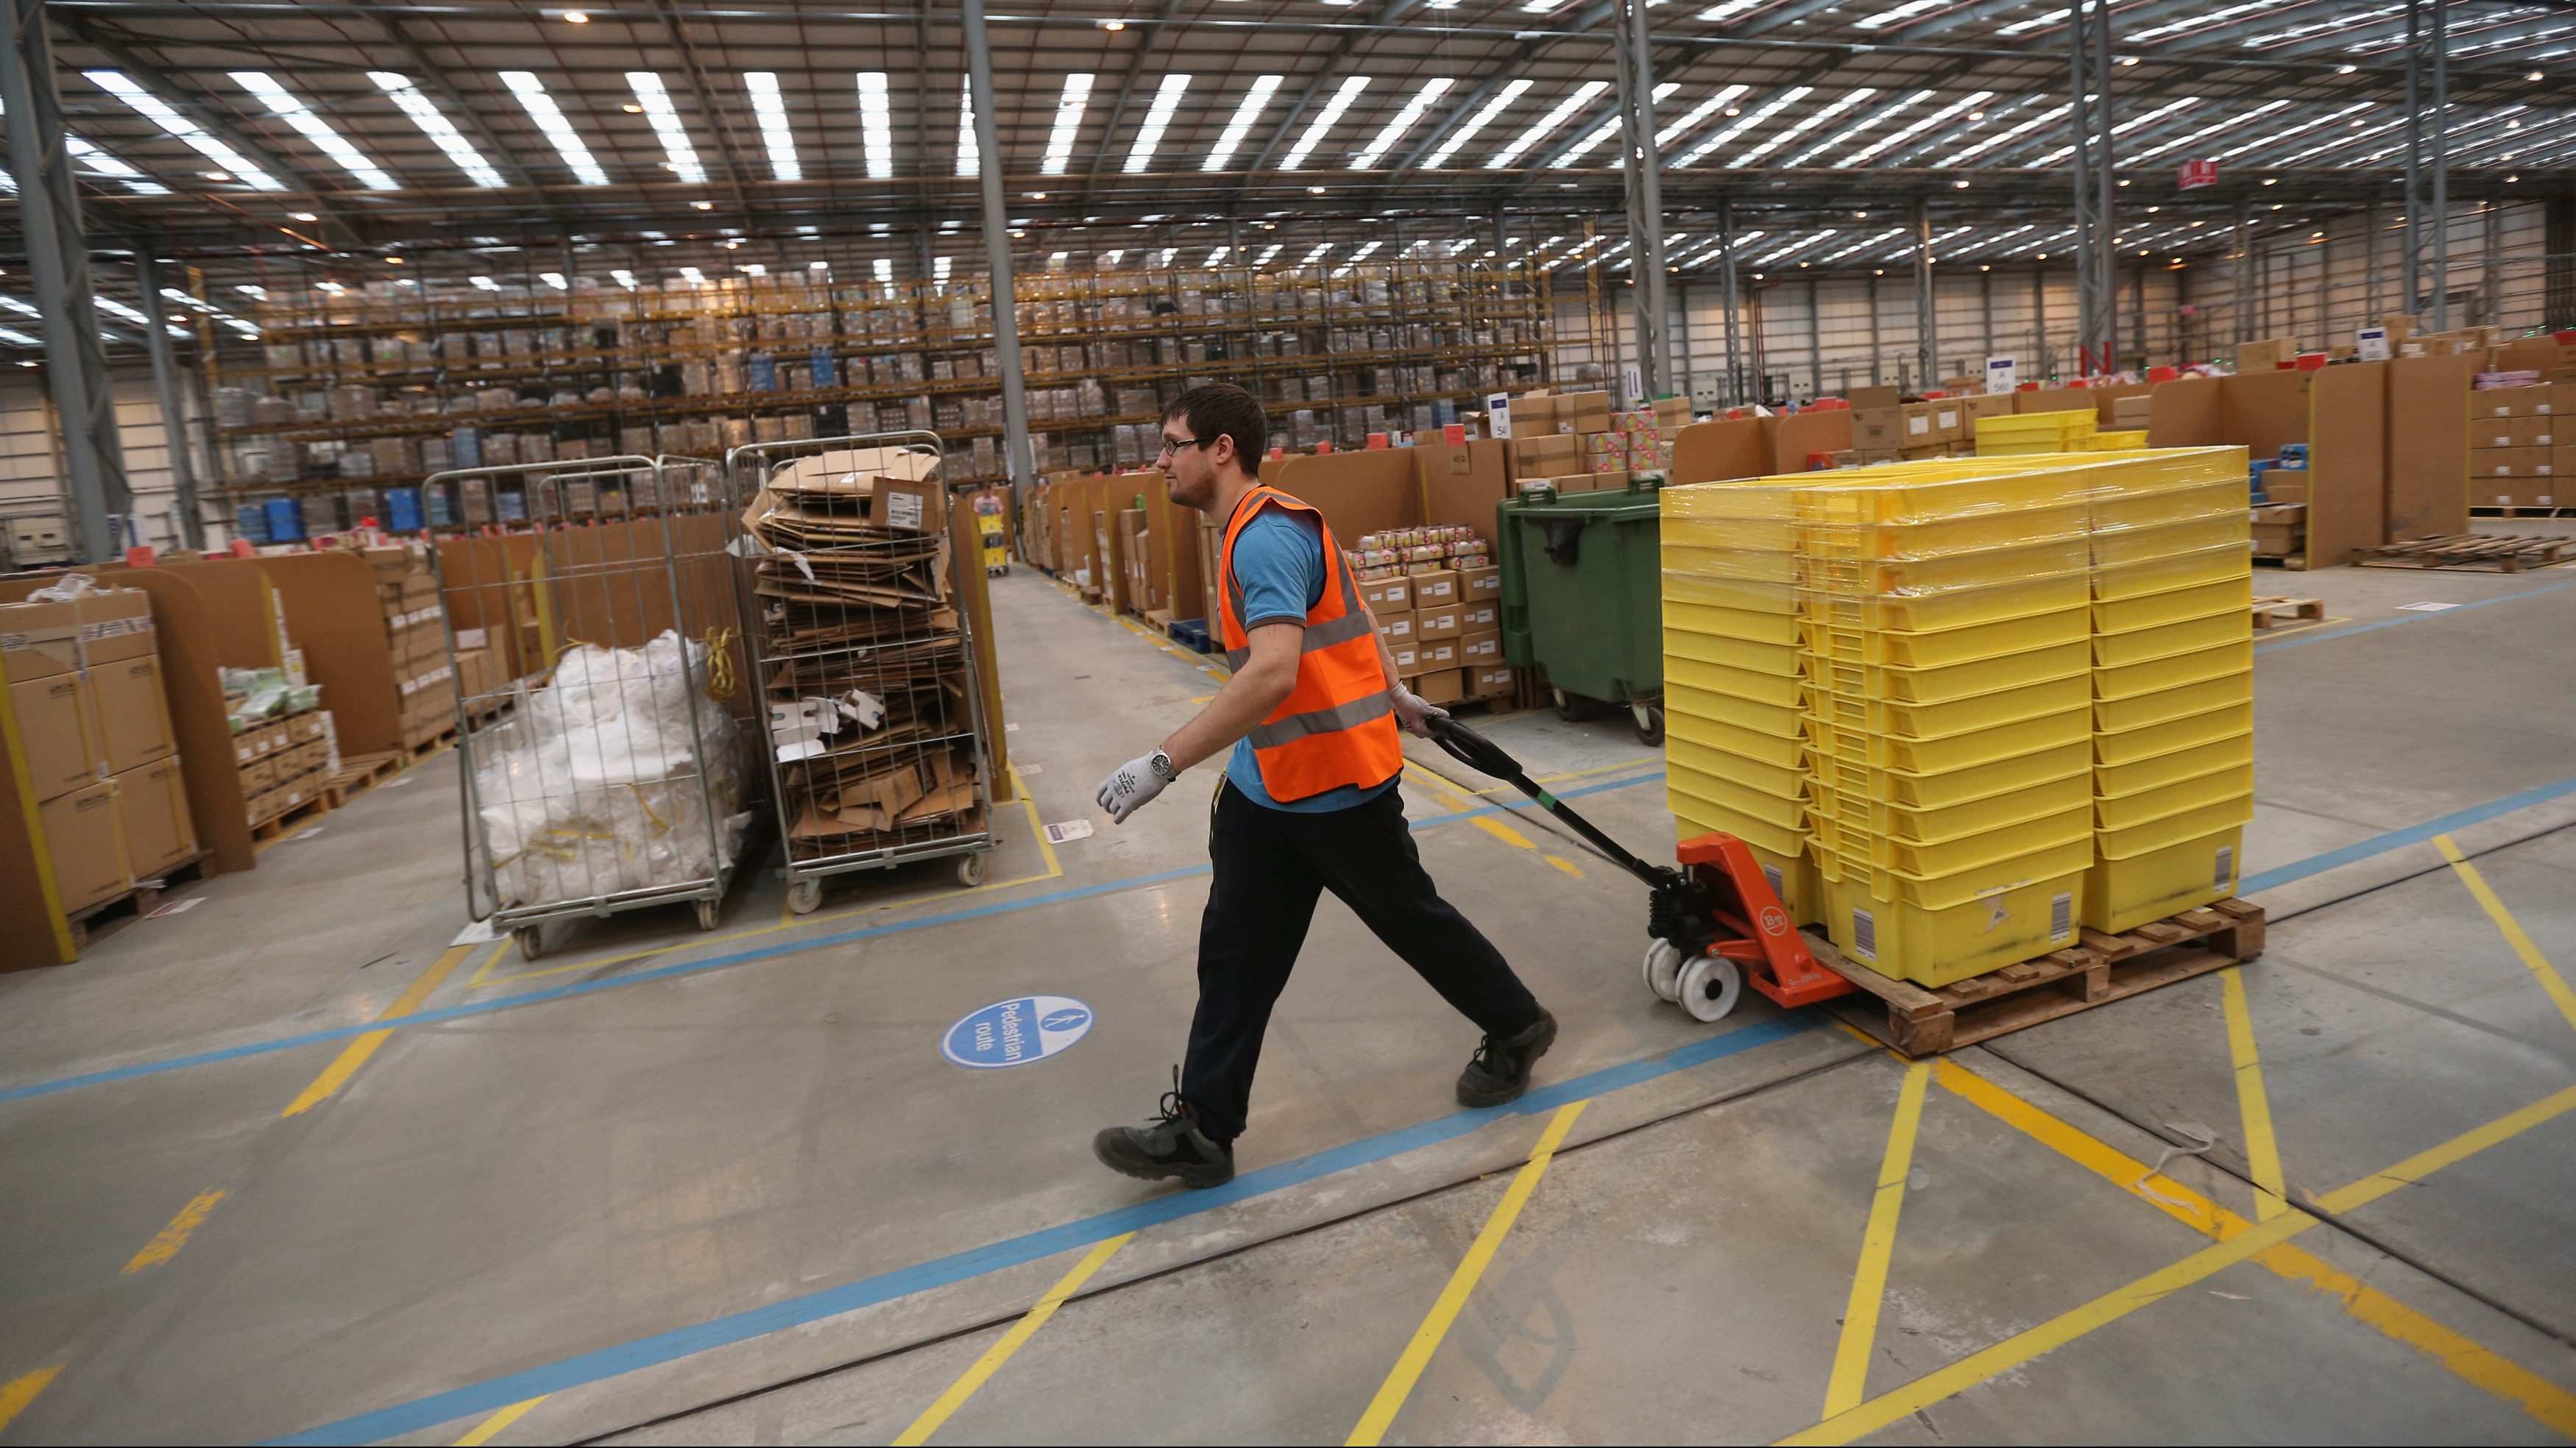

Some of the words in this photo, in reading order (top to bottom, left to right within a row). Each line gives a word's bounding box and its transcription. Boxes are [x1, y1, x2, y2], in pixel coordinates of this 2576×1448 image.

[1998, 370, 2006, 379] A
[1763, 915, 1785, 927] BT
[975, 1021, 996, 1051] route
[1000, 1002, 1025, 1061] Pedestrian
